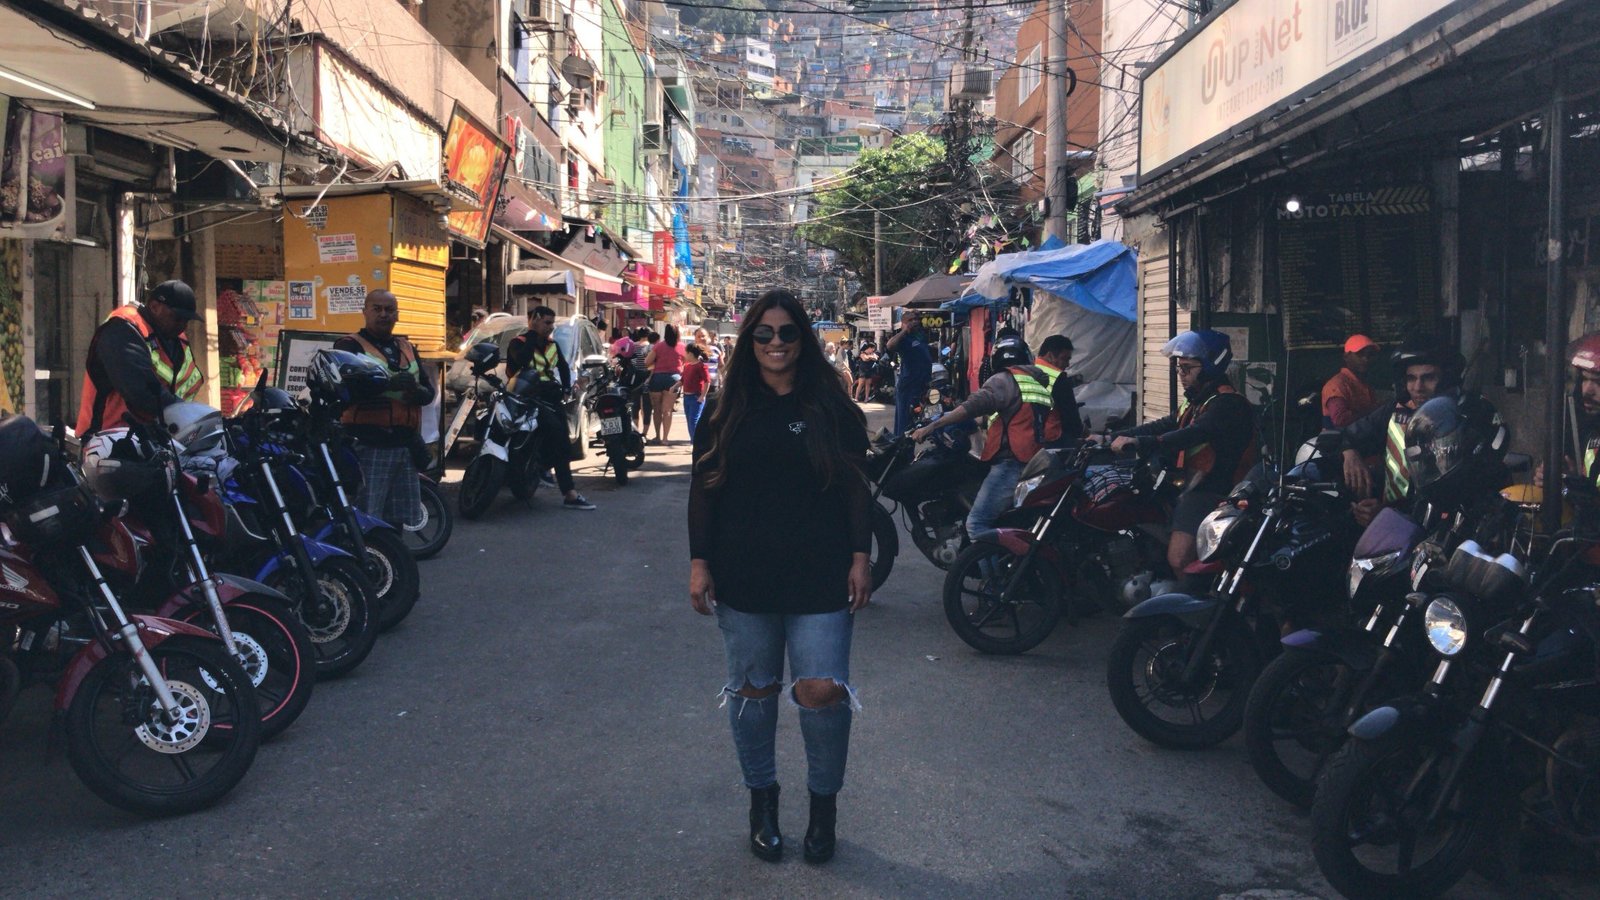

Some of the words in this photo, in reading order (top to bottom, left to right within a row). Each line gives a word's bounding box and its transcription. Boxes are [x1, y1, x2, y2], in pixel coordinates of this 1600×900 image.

[1260, 0, 1303, 65] Net
[1335, 0, 1369, 41] BLUE
[1328, 192, 1373, 203] TABELA
[329, 286, 366, 294] VENDE-SE
